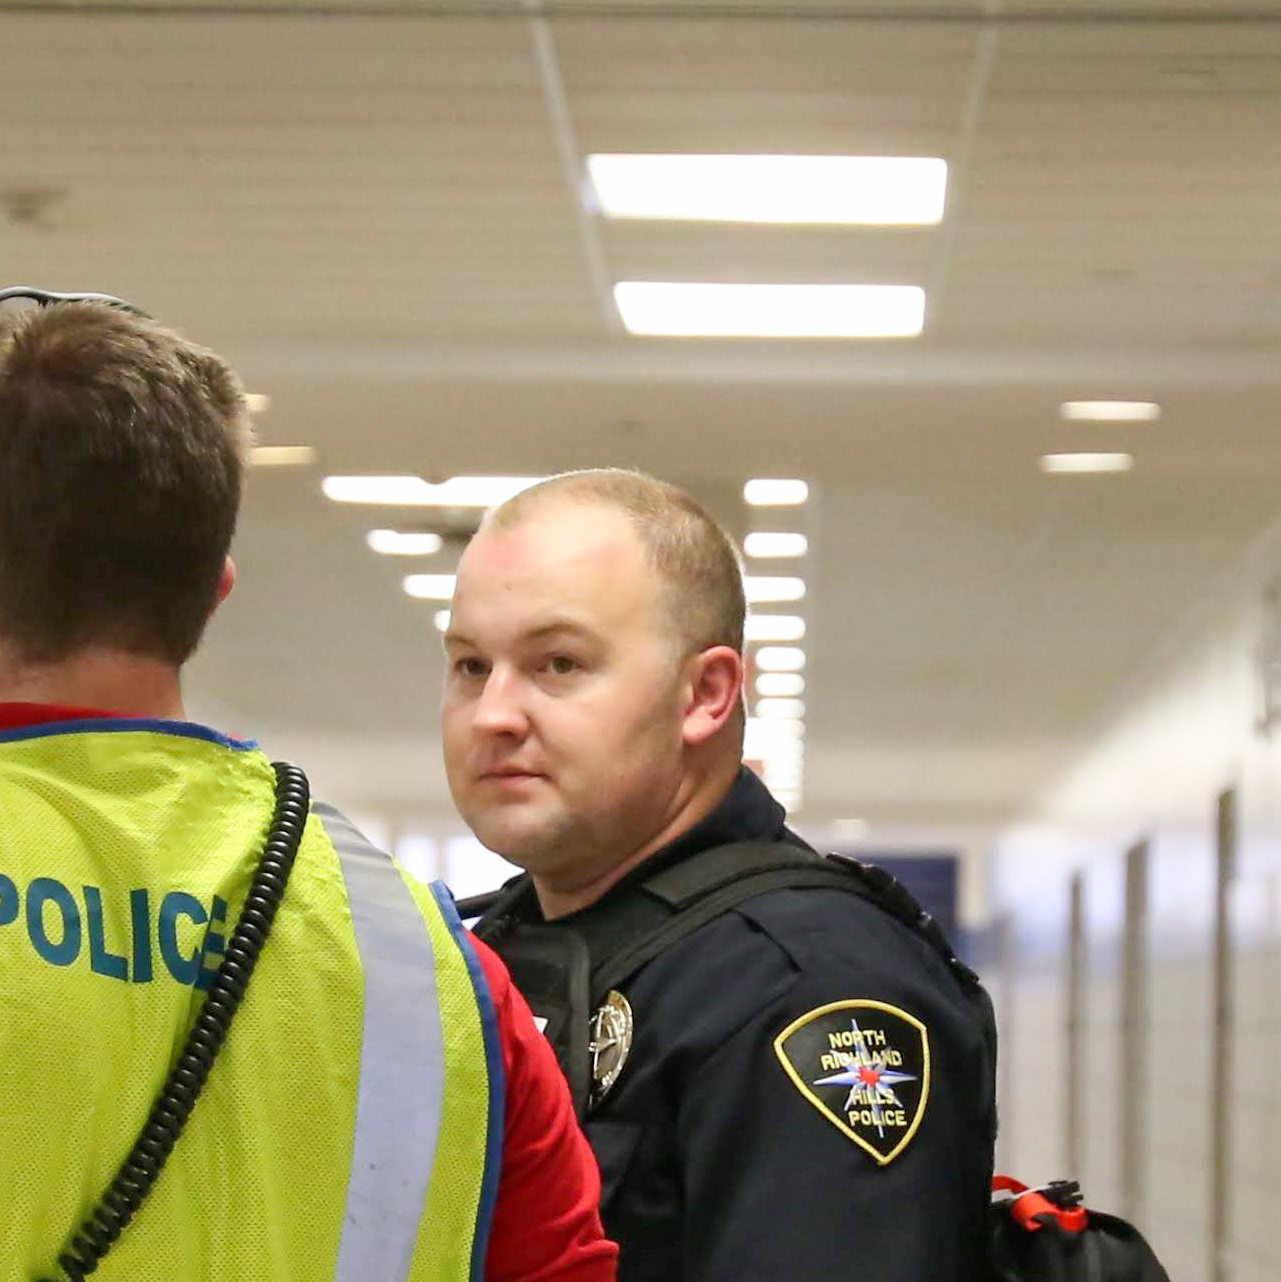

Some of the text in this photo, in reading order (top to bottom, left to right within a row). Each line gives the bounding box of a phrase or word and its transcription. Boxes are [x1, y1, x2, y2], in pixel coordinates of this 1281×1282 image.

[829, 1030, 886, 1048] NORTH
[821, 1050, 902, 1070] RICHLAND
[850, 1087, 896, 1105] HILLS
[849, 1110, 907, 1126] POLICE
